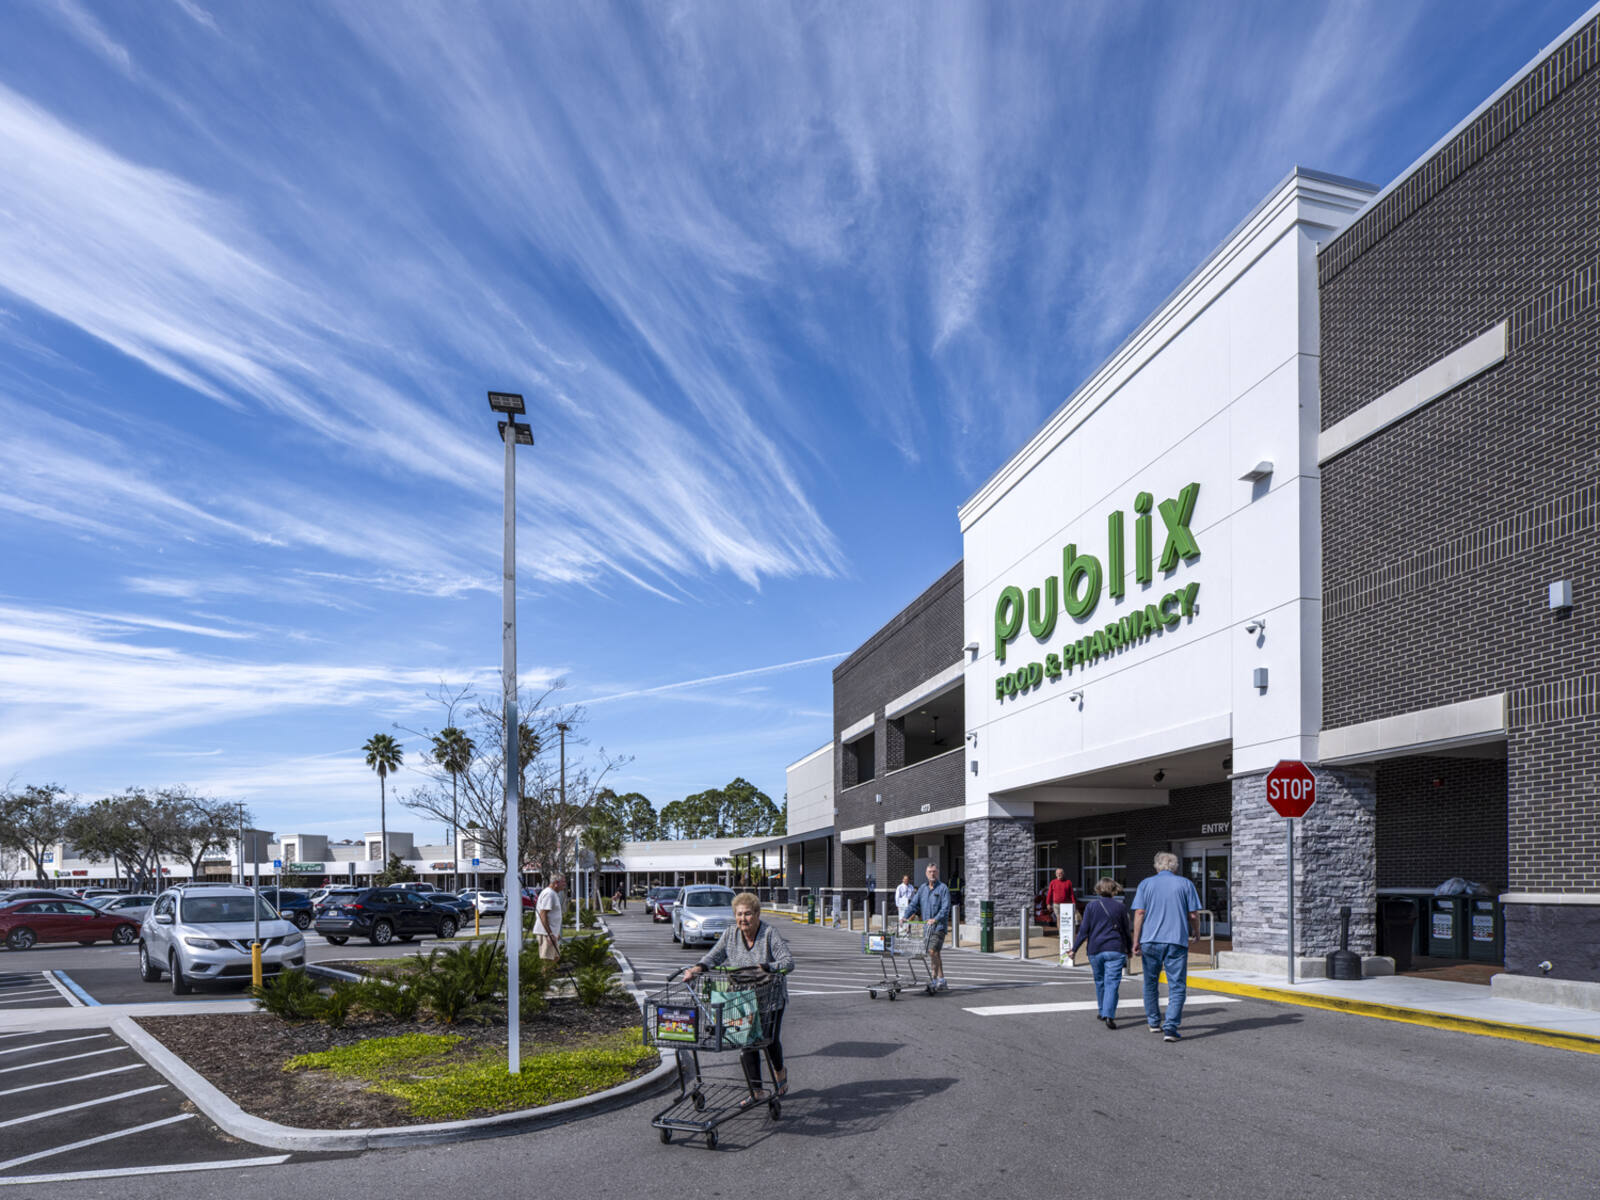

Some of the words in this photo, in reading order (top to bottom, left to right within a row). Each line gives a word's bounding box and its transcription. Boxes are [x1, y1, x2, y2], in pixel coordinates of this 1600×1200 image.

[996, 662, 1043, 700] FOOD
[1045, 653, 1062, 678] &
[1063, 582, 1200, 670] PHARMACY
[1269, 778, 1313, 800] STOP
[1201, 821, 1230, 834] ENTRY
